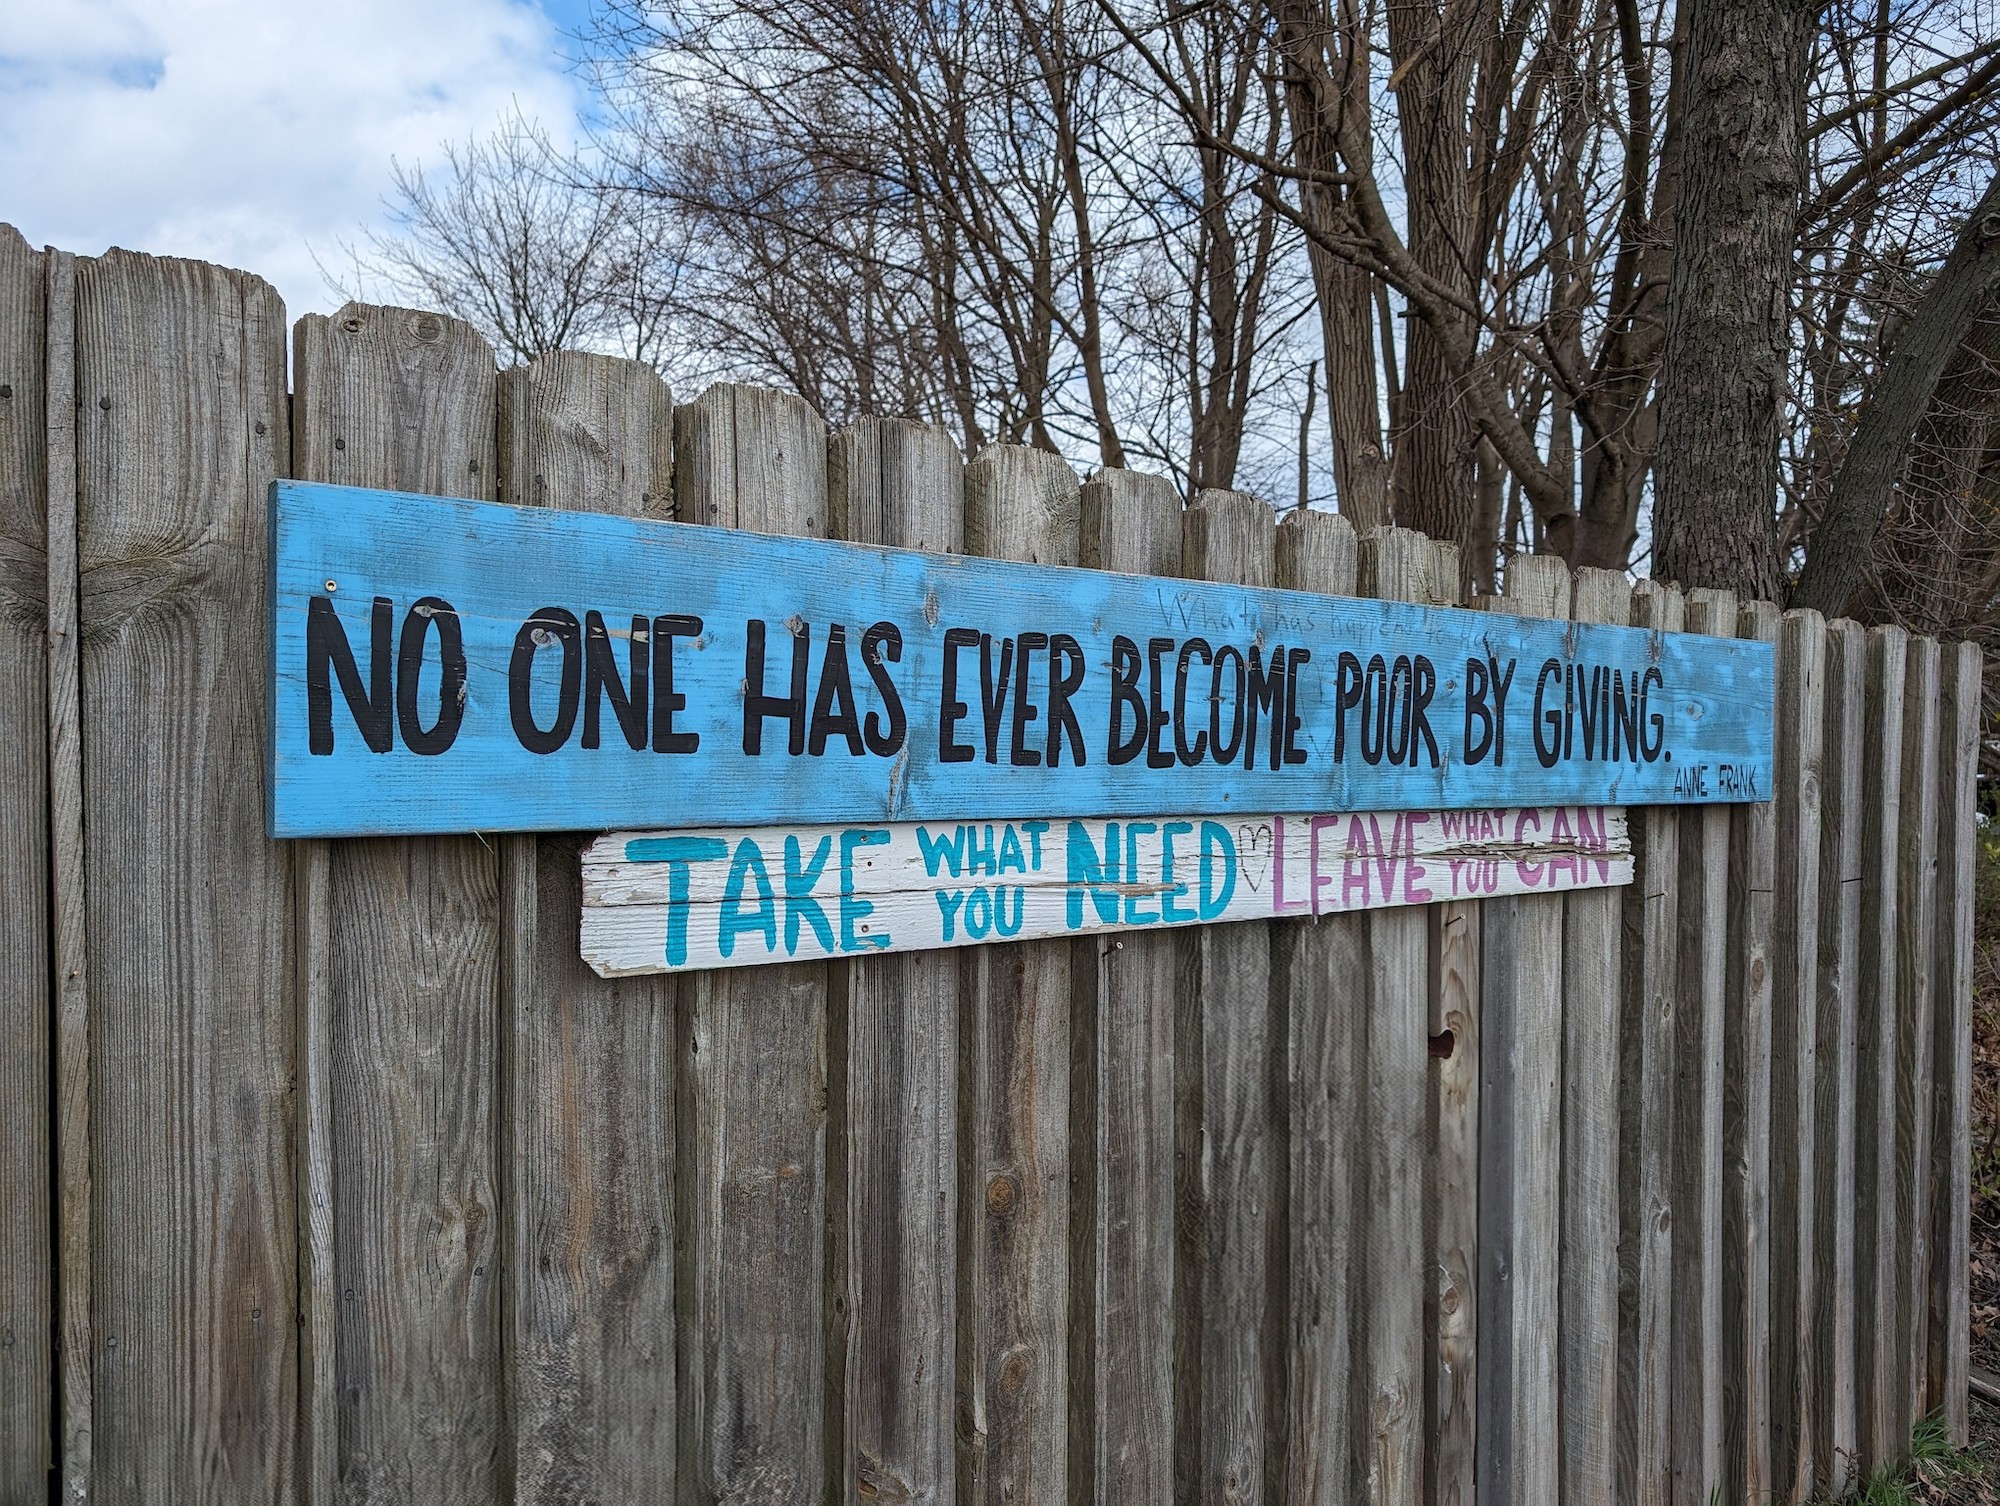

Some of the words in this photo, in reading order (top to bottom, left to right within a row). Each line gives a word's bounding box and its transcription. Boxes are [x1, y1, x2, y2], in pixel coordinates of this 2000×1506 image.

[307, 596, 466, 756] NO
[509, 606, 704, 754] ONE
[742, 615, 907, 756] HAS
[939, 628, 1086, 768] EVER
[1107, 635, 1310, 771] BECOME
[1333, 651, 1440, 768] POOR
[1463, 657, 1517, 767] BY
[1533, 657, 1672, 768] GIVING.
[1673, 764, 1708, 799] ANNE
[1719, 764, 1758, 798] FRANK
[915, 821, 1050, 877] WHAT
[1440, 808, 1507, 842] WHAT
[1513, 805, 1609, 888] CAN
[625, 829, 892, 967] TAKE
[1066, 819, 1236, 930] NEED
[1272, 811, 1434, 924] LEAVE
[1448, 858, 1500, 897] YOU
[935, 885, 1025, 942] YOU
